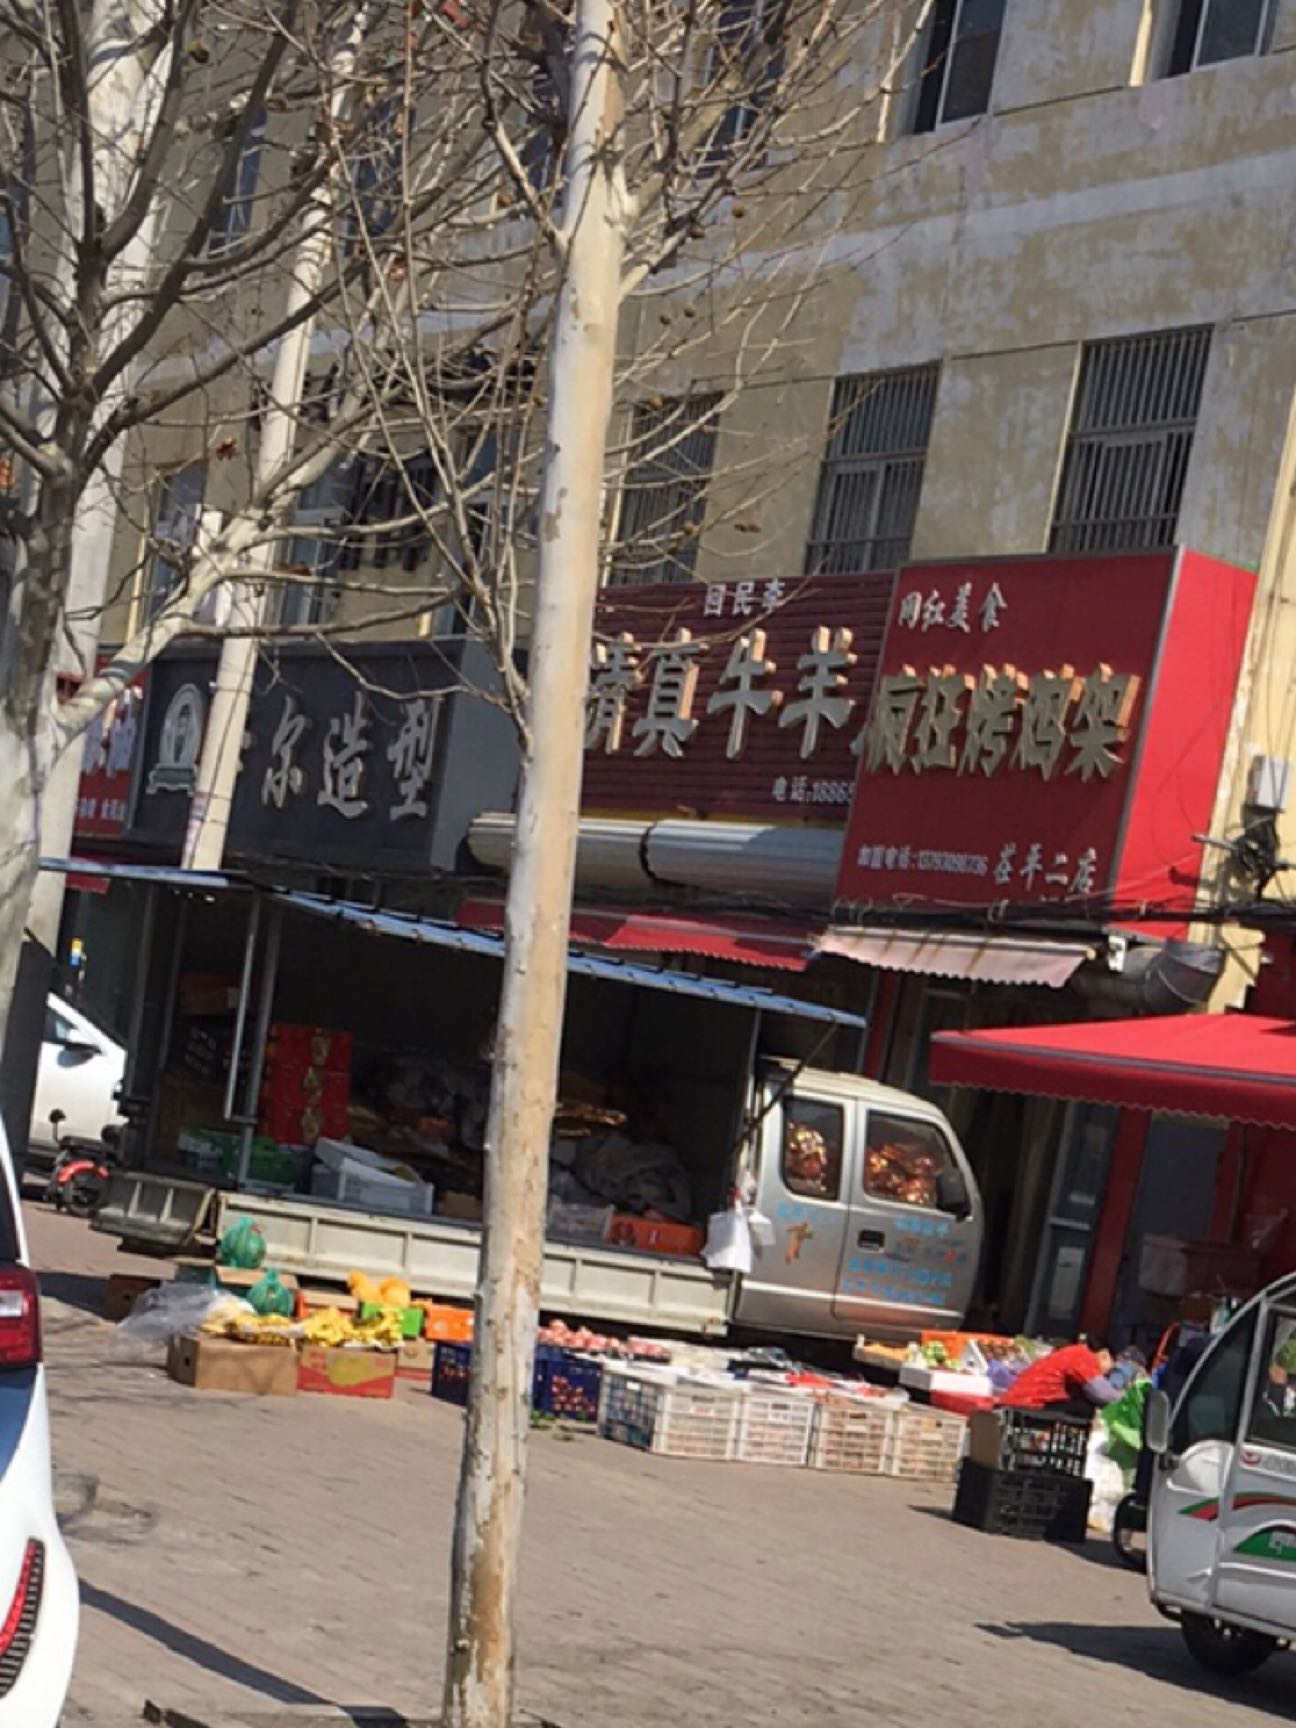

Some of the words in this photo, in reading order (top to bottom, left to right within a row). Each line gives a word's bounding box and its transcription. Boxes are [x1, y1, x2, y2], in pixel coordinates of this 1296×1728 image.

[899, 582, 1007, 633] 网红美食
[238, 691, 444, 819] 尔造型
[582, 626, 866, 760] 清真牛羊
